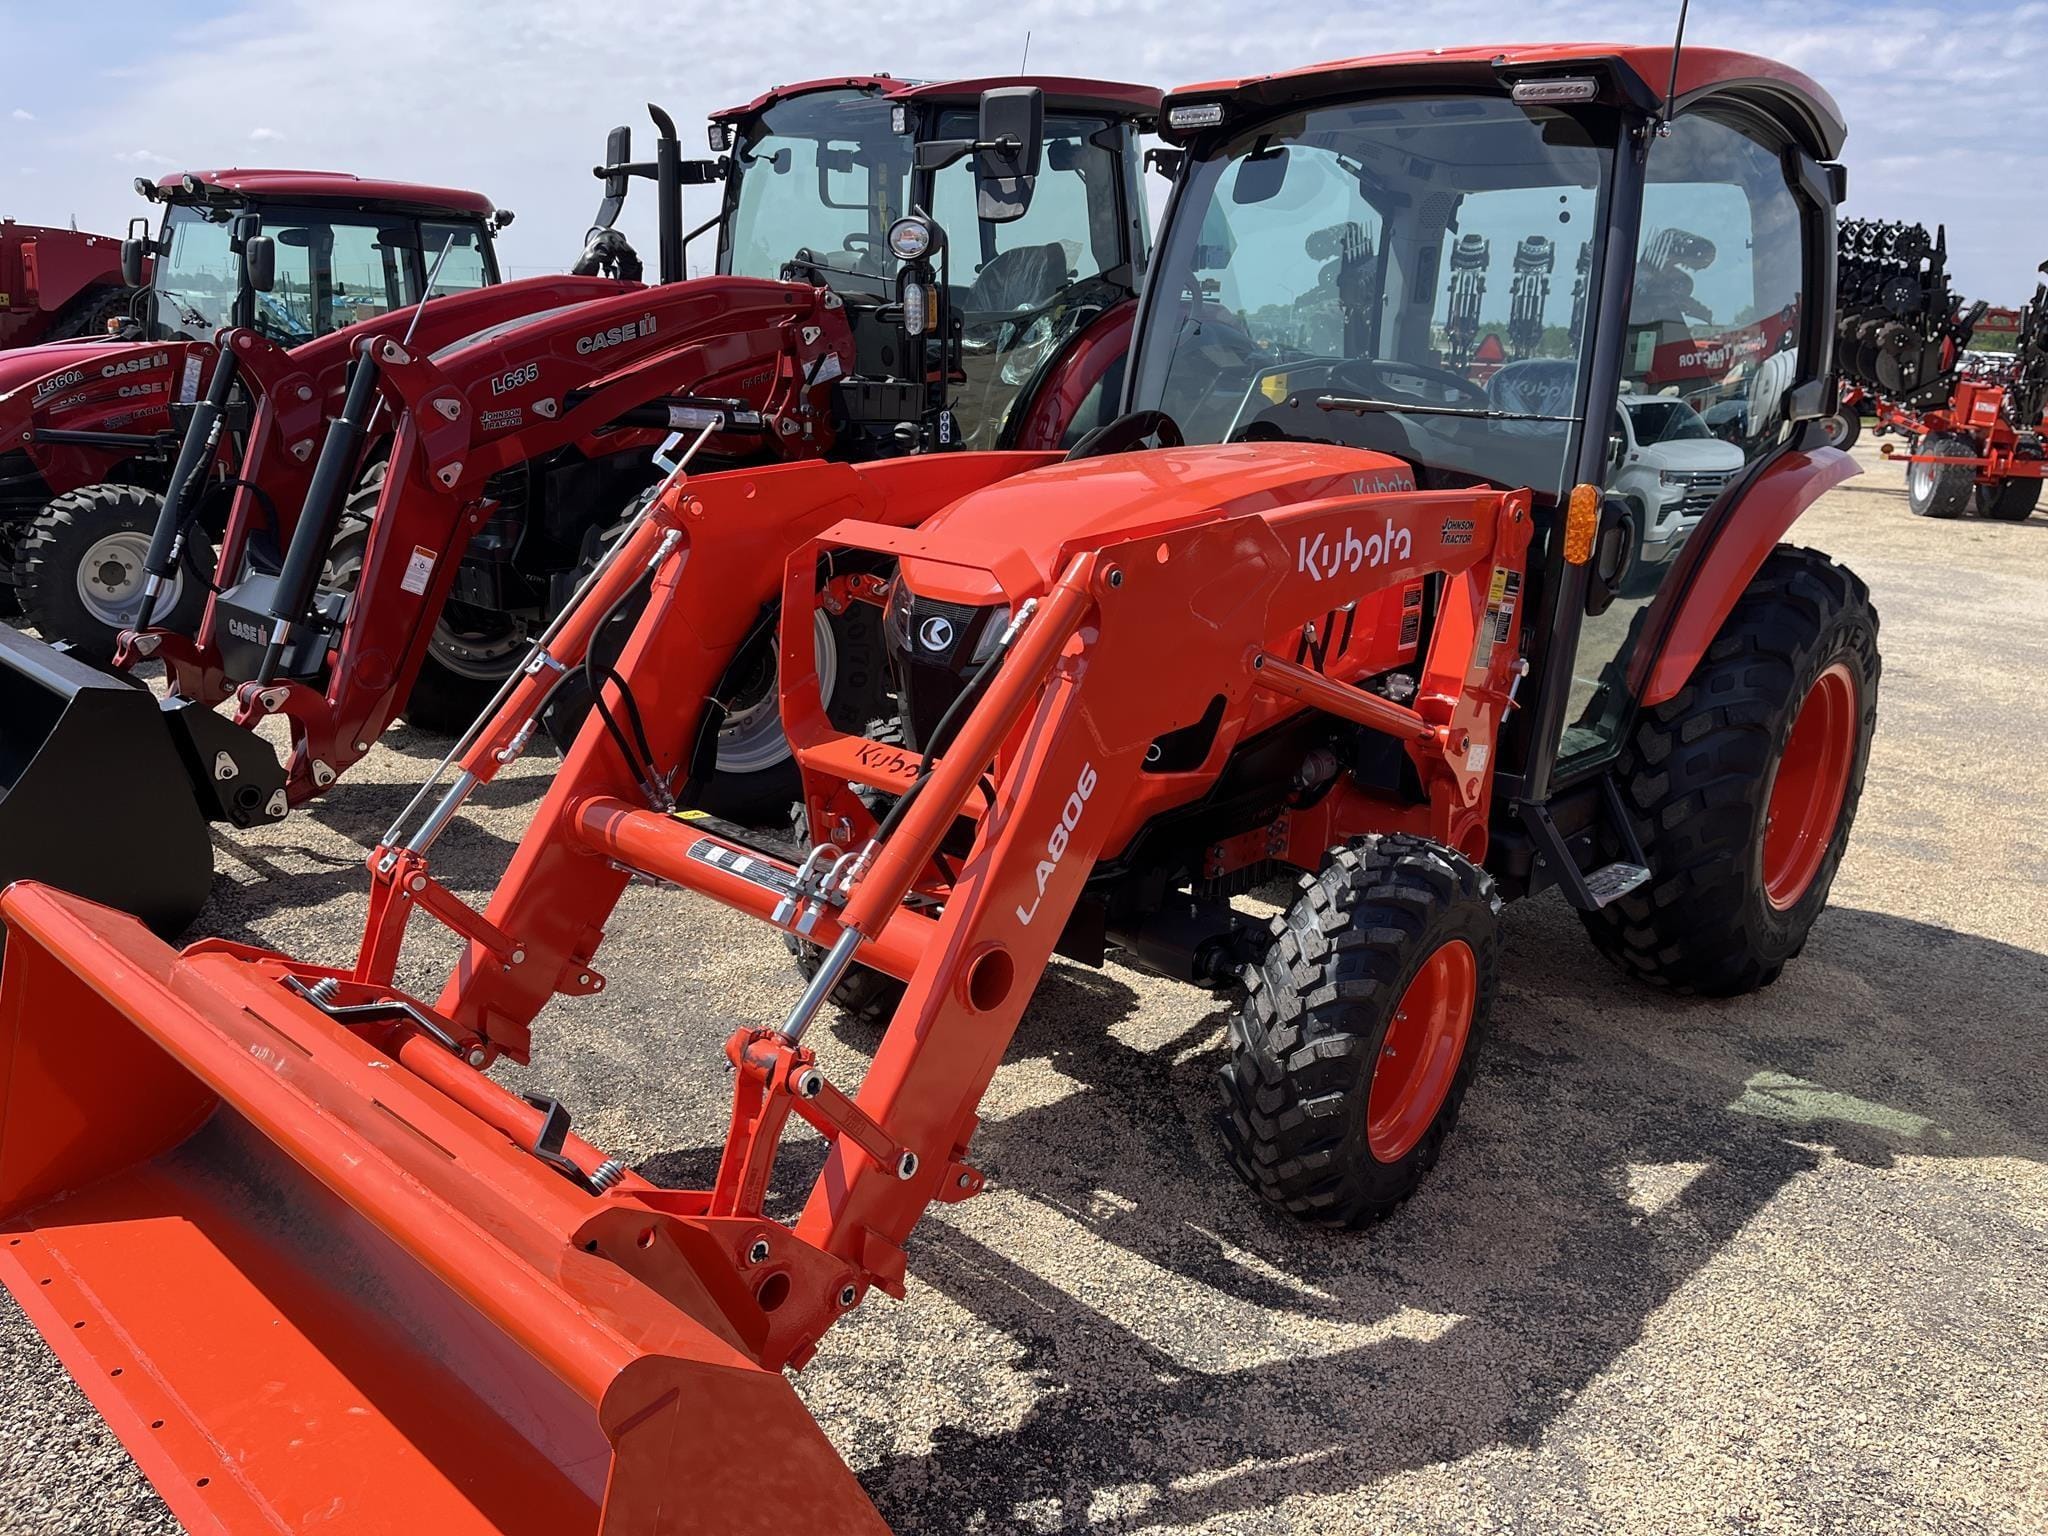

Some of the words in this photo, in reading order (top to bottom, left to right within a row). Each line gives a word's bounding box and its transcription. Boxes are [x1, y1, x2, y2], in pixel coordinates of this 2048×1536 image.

[576, 323, 636, 355] CASE
[101, 358, 151, 378] CASE
[37, 370, 85, 397] L360A
[491, 363, 539, 396] L635
[742, 369, 775, 390] FARMA
[1512, 379, 1570, 397] Kubot
[118, 383, 161, 398] CASE
[133, 405, 168, 419] FARMA
[480, 408, 522, 420] JOHNSON
[481, 417, 522, 430] TRACTOR
[1352, 473, 1413, 495] Kubota
[1441, 517, 1475, 531] JOHNSON
[1440, 531, 1473, 545] TRACTOR
[1298, 518, 1412, 582] Kubota
[229, 618, 257, 643] CASE
[855, 743, 921, 778] Kubo
[1015, 761, 1098, 926] LA806
